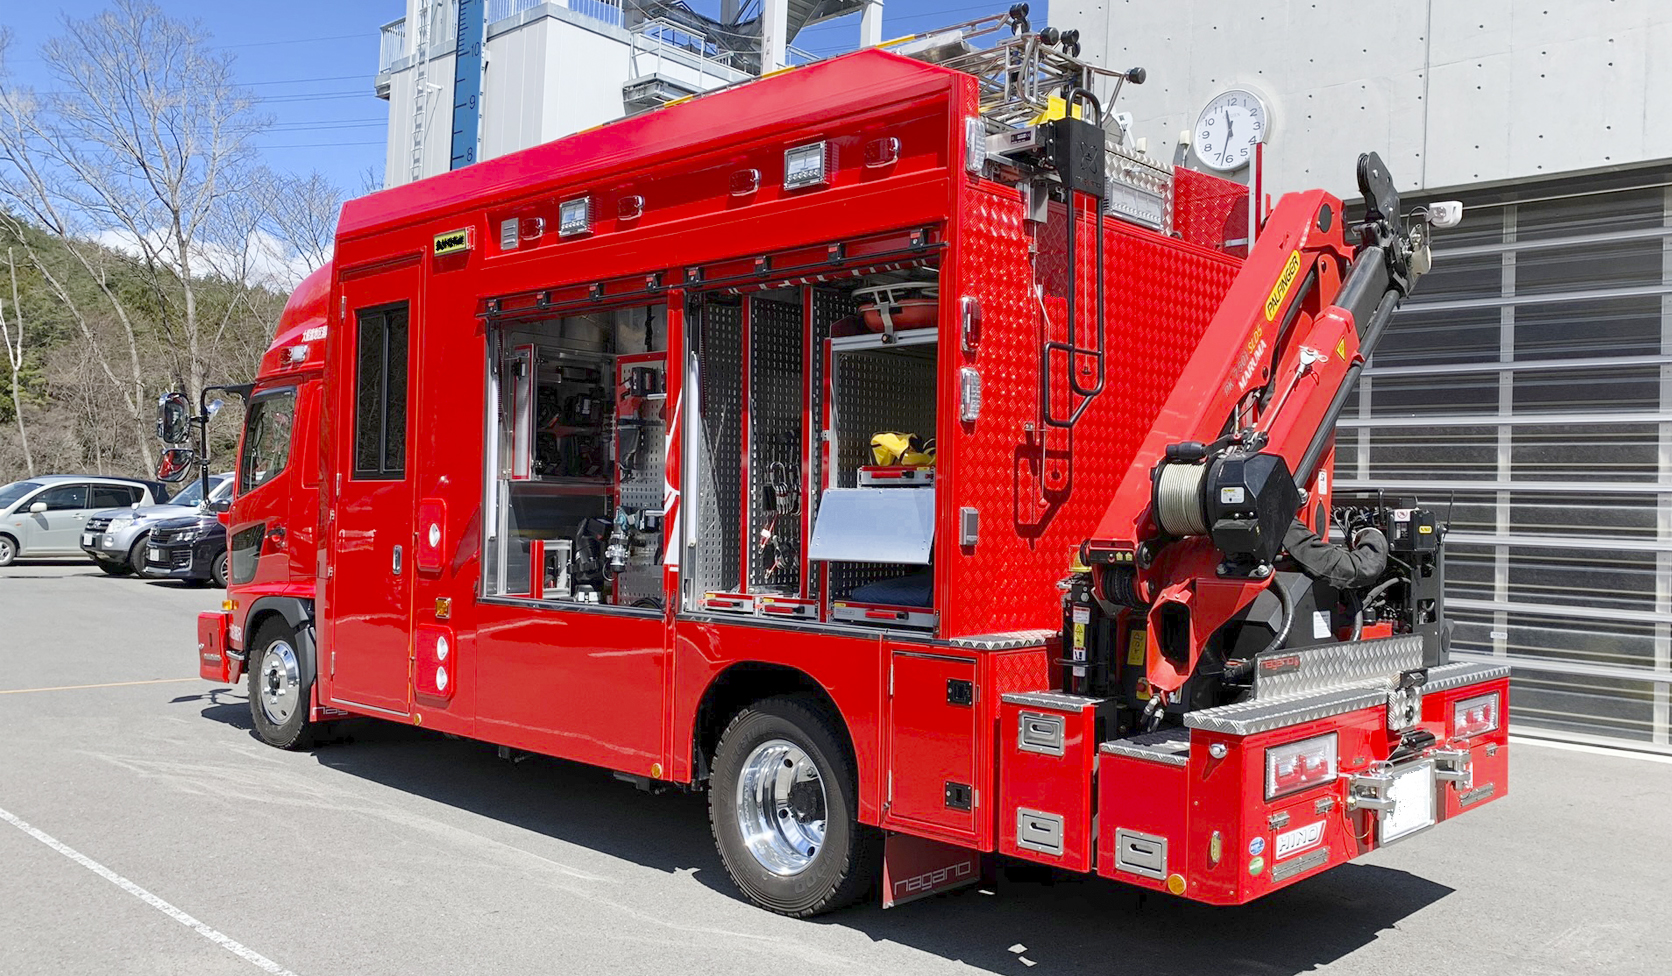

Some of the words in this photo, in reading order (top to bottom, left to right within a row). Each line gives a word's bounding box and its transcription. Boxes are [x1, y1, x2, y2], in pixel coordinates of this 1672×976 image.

[471, 42, 480, 57] 10
[469, 94, 476, 110] 9
[1227, 98, 1237, 106] 12
[1214, 106, 1223, 114] 11
[1250, 108, 1257, 117] 2
[1205, 118, 1215, 126] 10
[1253, 122, 1260, 130] 3
[1202, 131, 1210, 139] 9
[1248, 136, 1257, 145] 4
[1204, 144, 1212, 152] 8
[1240, 148, 1248, 156] 5
[466, 146, 474, 162] 8
[1214, 153, 1221, 161] 7
[1225, 155, 1233, 163] 6
[1266, 254, 1299, 318] PALFINGER
[1238, 338, 1267, 393] MARUMA
[1278, 825, 1319, 853] HINO
[893, 860, 971, 896] nagano
